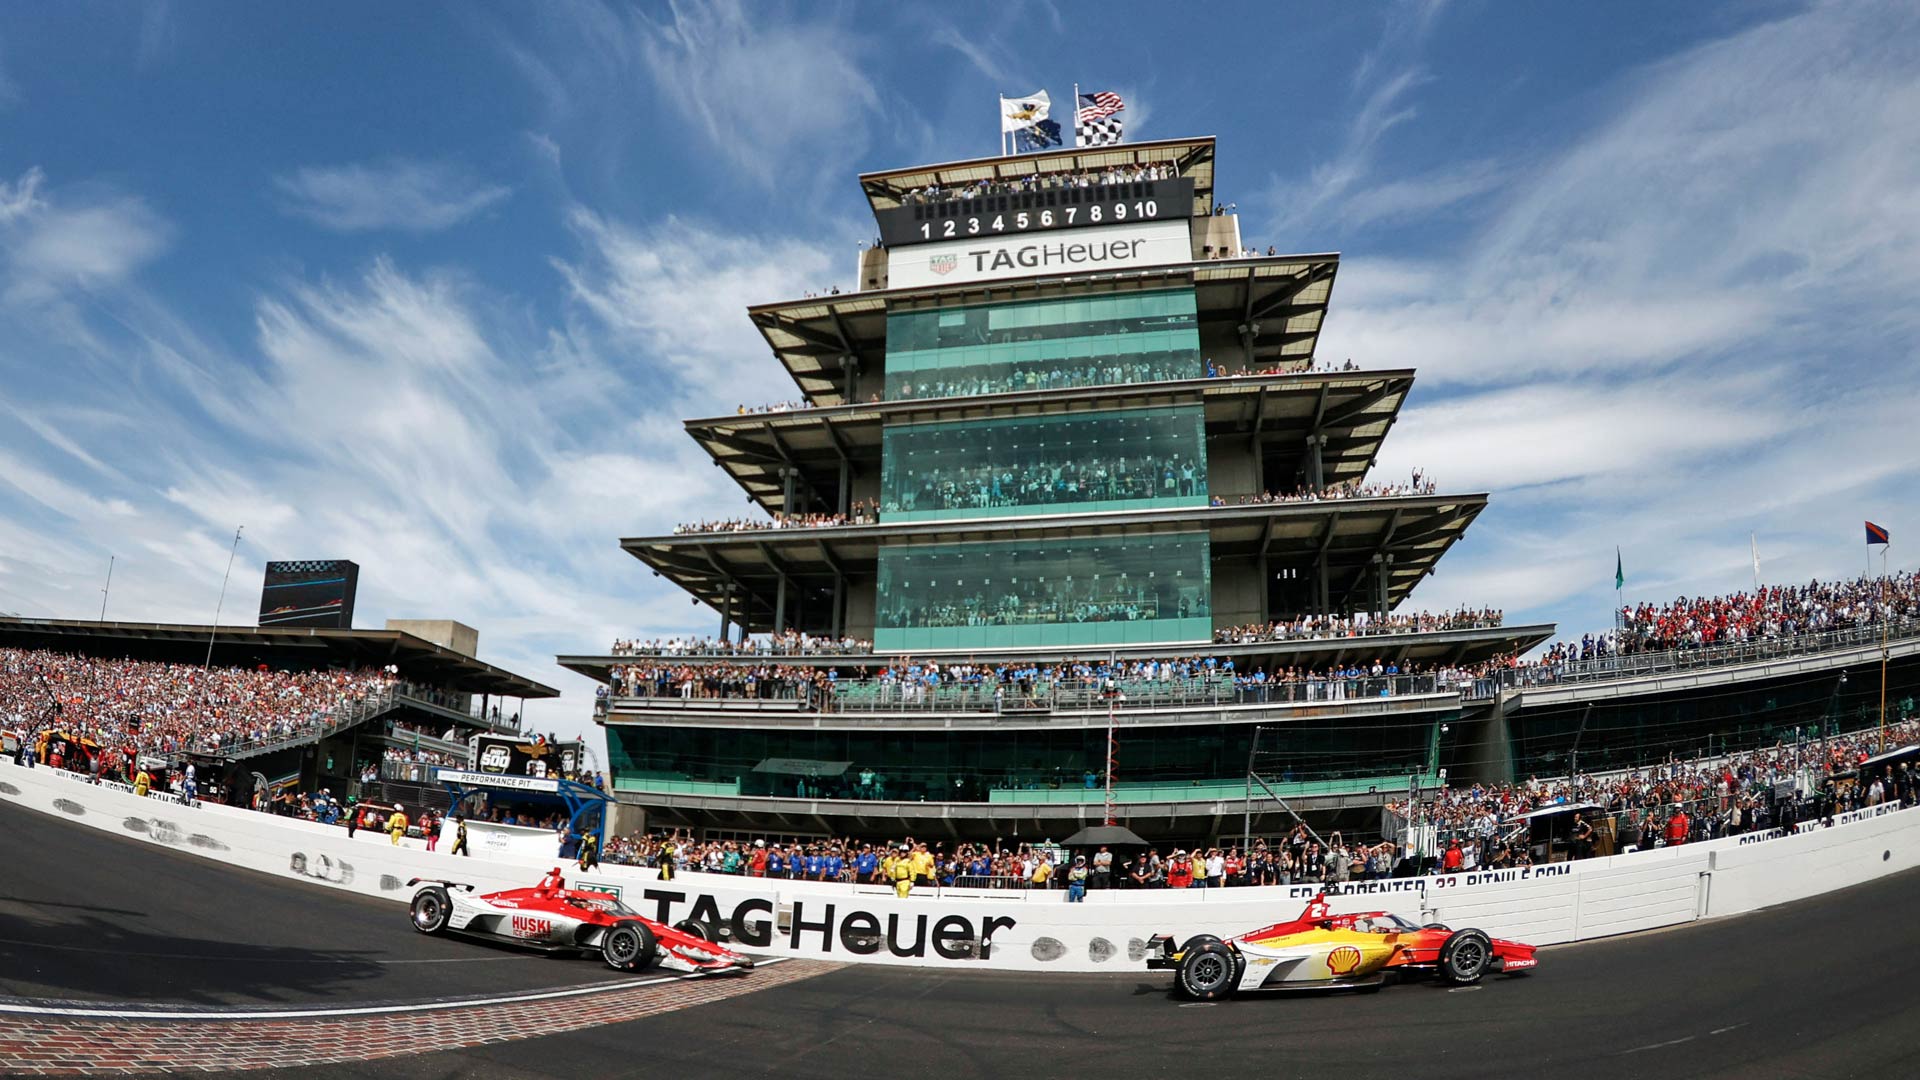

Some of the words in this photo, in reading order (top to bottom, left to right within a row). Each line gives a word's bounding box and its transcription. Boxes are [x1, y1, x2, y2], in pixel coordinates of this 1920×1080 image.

[921, 223, 931, 239] 1
[943, 220, 956, 237] 2
[968, 218, 980, 234] 3
[992, 215, 1005, 231] 4
[1016, 212, 1029, 229] 5
[1041, 210, 1053, 226] 6
[1065, 207, 1078, 224] 7
[1090, 205, 1103, 222] 8
[1115, 203, 1127, 220] 9
[1135, 200, 1158, 219] 10
[480, 752, 511, 769] 500
[461, 774, 516, 787] PERFORMANCE
[518, 779, 532, 788] PIT
[1310, 903, 1323, 918] 2
[512, 914, 551, 933] HUSKI
[644, 888, 773, 947] TAG
[790, 902, 1017, 961] Heuer
[1505, 959, 1536, 968] HITACHI
